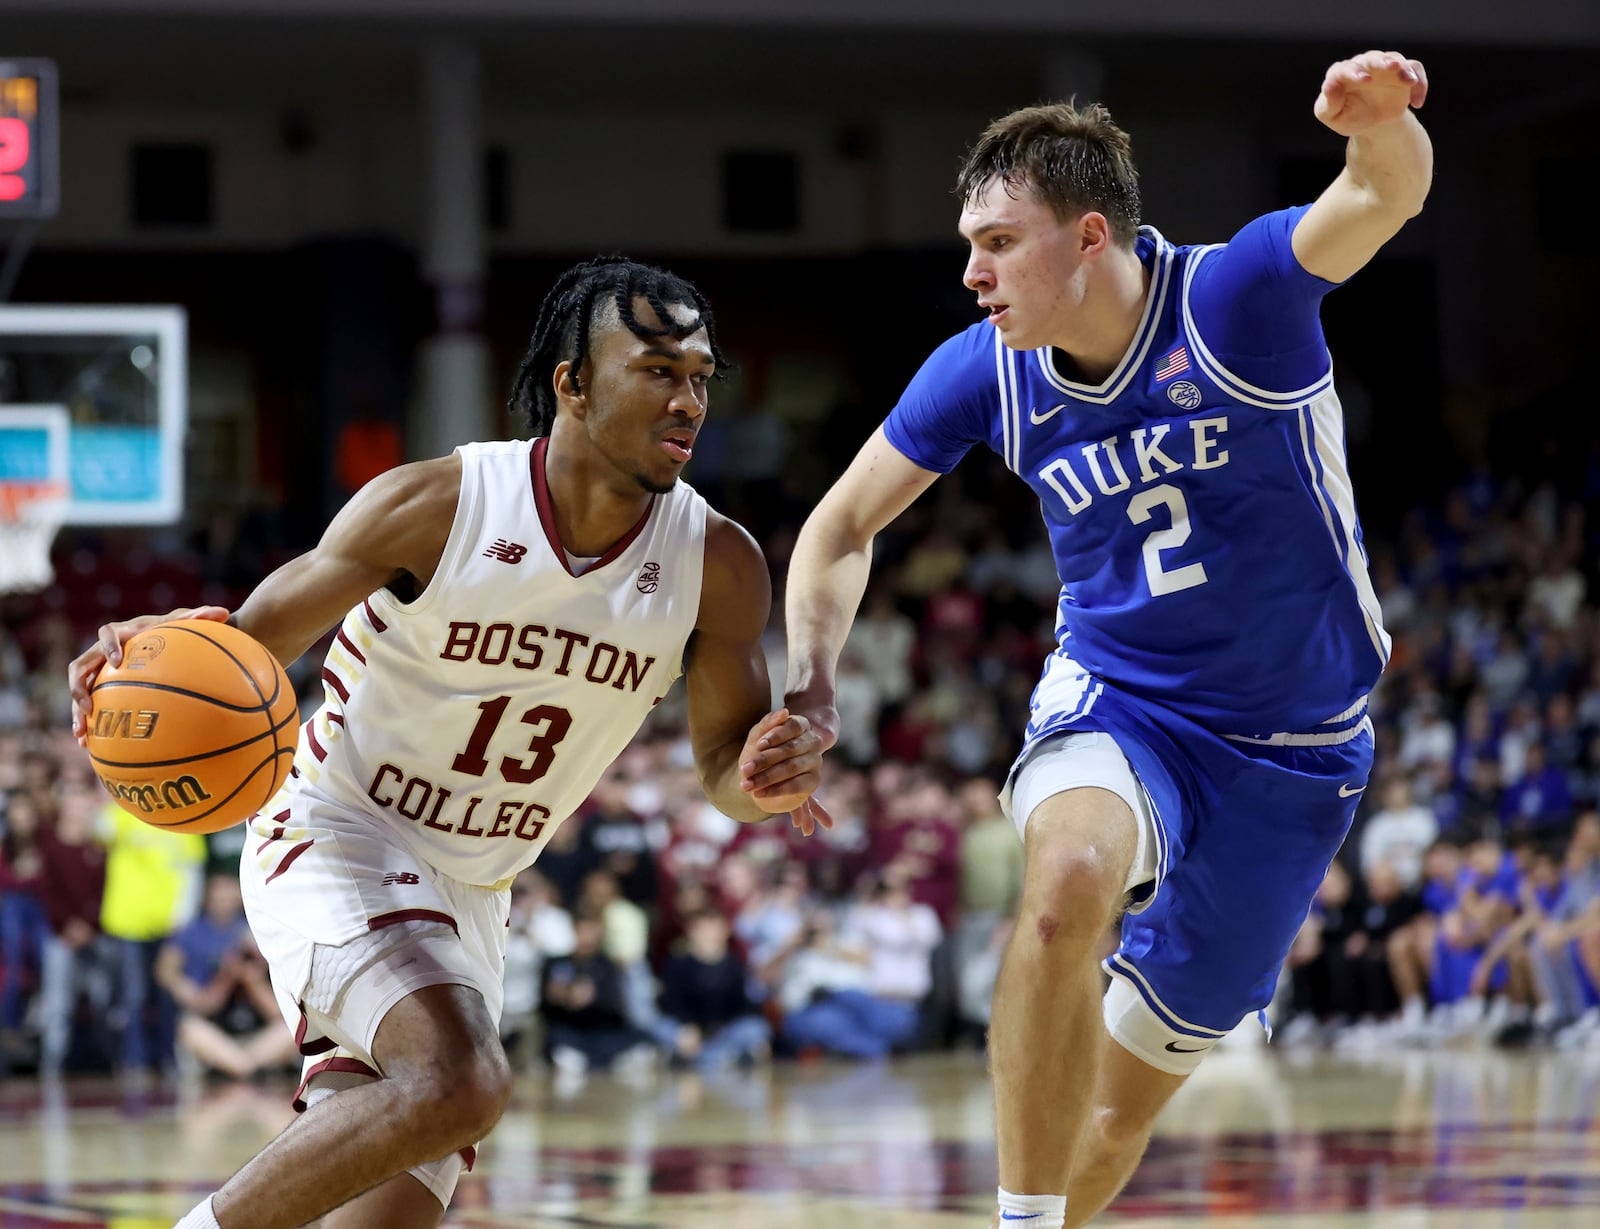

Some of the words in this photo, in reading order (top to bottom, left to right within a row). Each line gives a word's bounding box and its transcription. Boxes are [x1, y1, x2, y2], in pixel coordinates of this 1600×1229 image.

[1038, 416, 1229, 516] DUKE
[482, 538, 528, 565] NB
[1126, 483, 1209, 598] 2
[440, 621, 655, 692] BOSTON
[95, 709, 159, 741] EVO
[451, 694, 574, 785] 13
[368, 763, 552, 841] COLLEG
